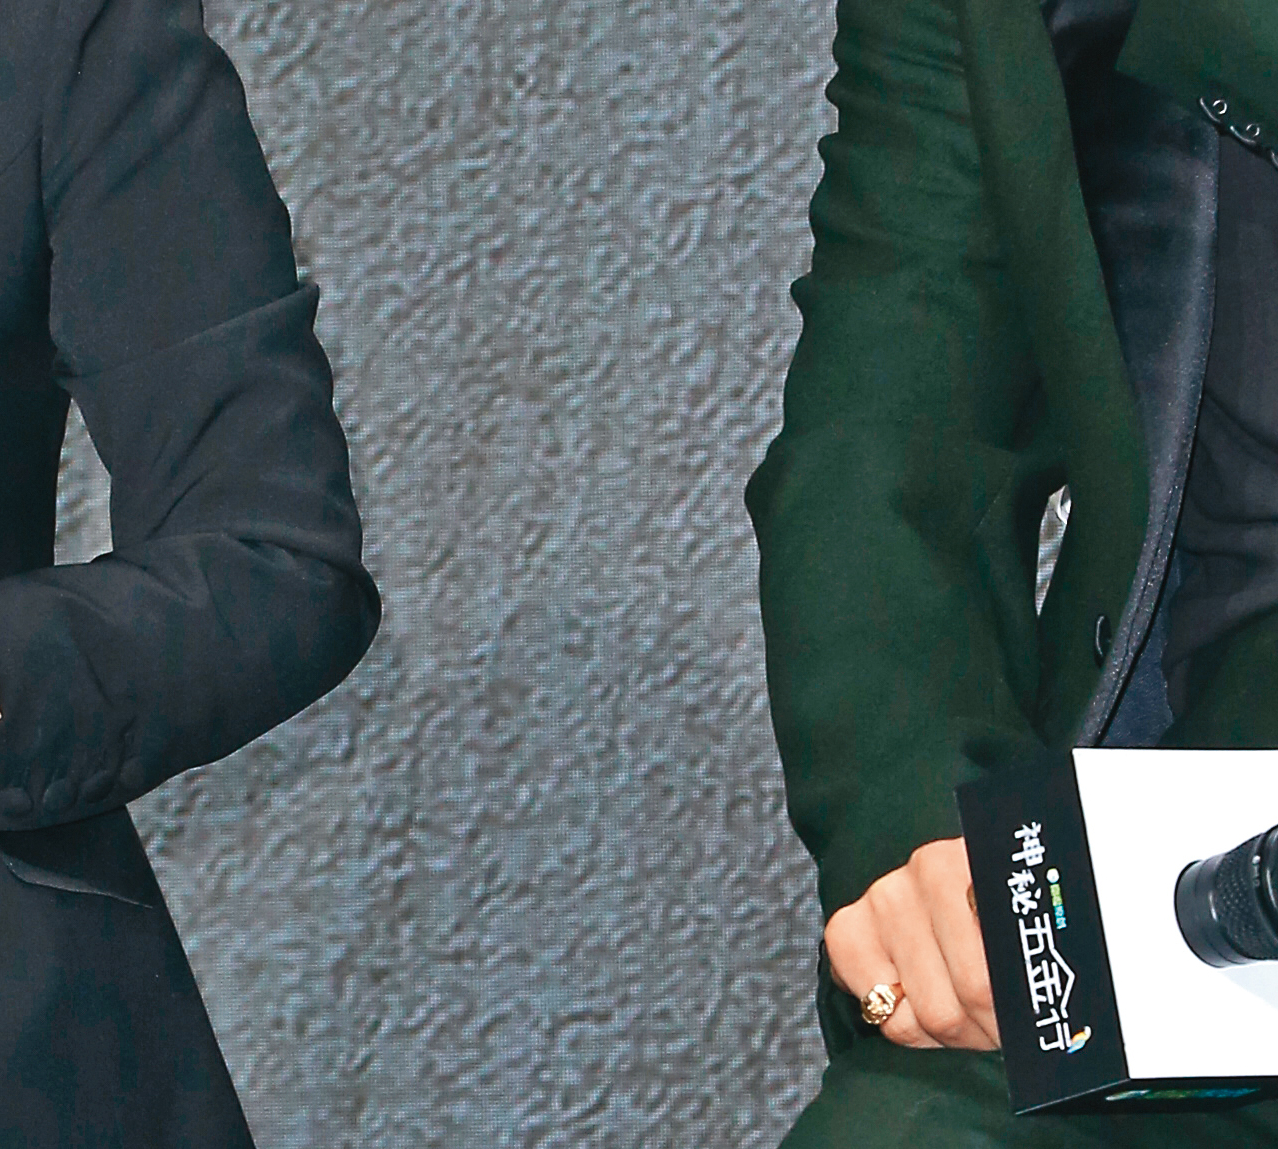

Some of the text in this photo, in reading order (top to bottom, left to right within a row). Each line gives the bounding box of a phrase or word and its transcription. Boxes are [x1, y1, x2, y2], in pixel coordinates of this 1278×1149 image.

[1007, 822, 1075, 1051] 神秘五金行
